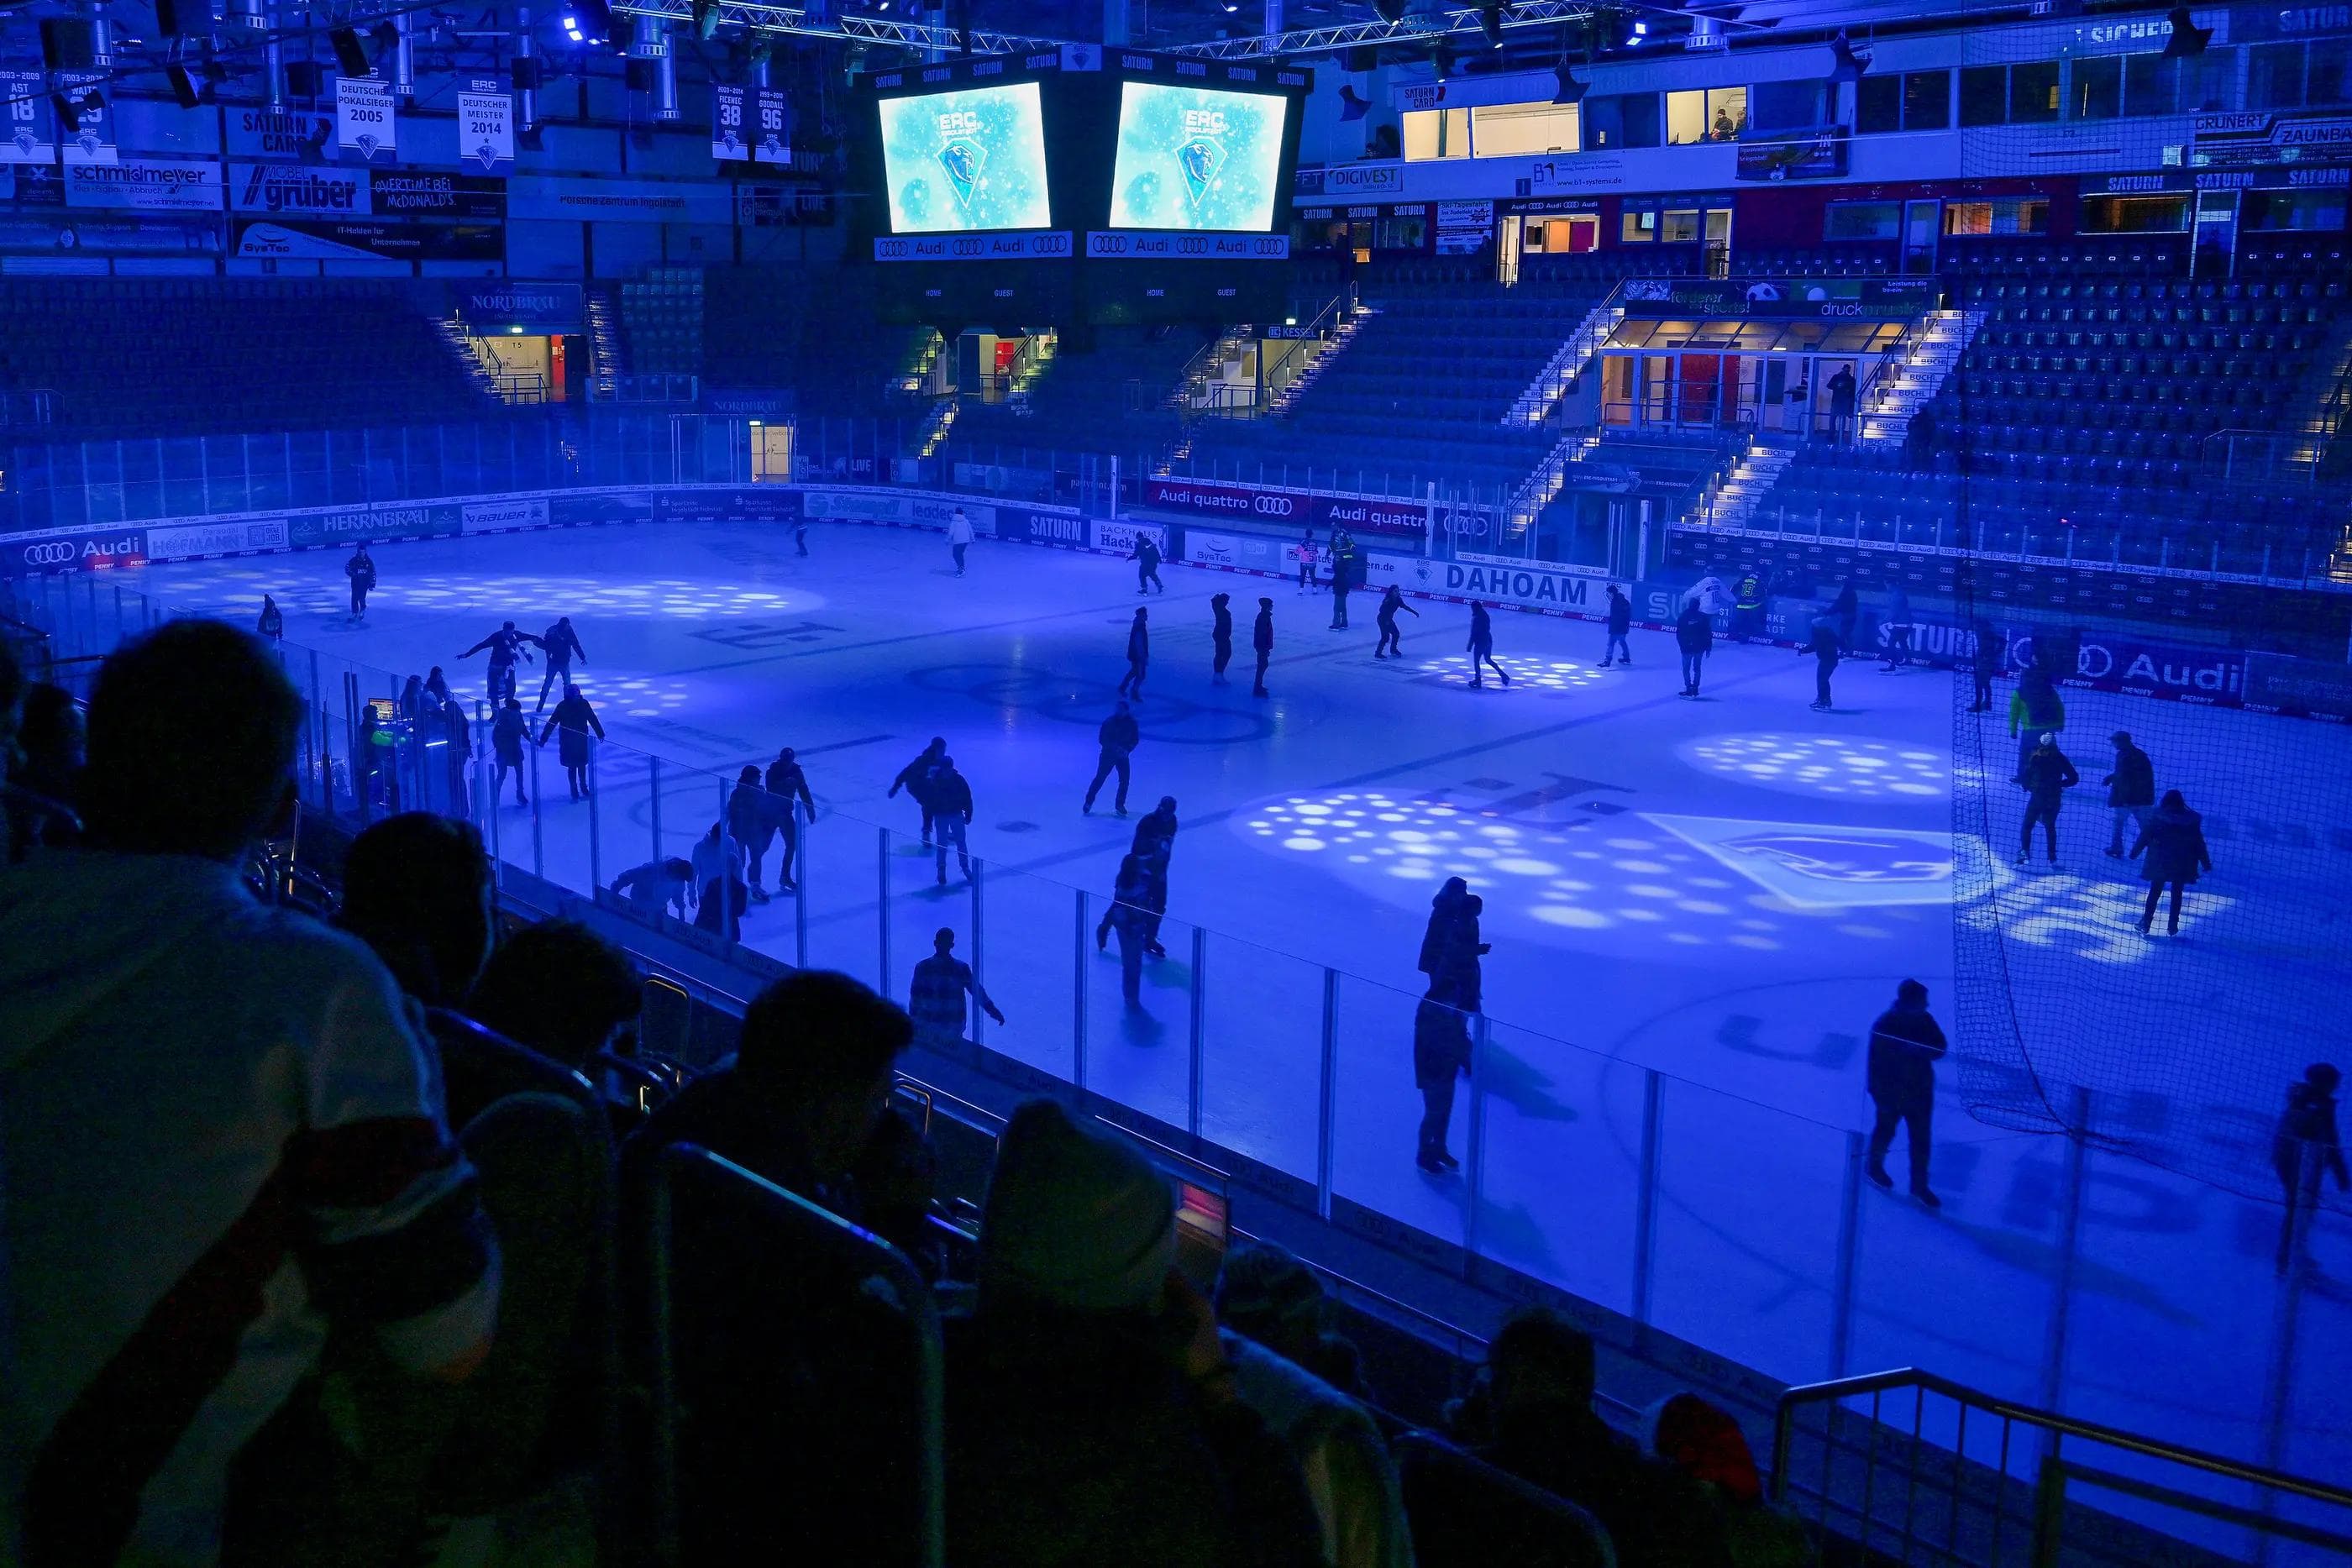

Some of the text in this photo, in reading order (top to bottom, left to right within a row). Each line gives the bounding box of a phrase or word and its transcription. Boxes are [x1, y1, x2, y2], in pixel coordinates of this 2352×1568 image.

[973, 60, 1002, 76] SATURN
[1026, 53, 1057, 70] SATURN
[1122, 55, 1153, 71] SATURN
[1176, 61, 1206, 76] SATURN
[875, 73, 901, 88] SATURN
[923, 67, 950, 82] SATURN
[1228, 67, 1257, 81] SATURN
[1278, 73, 1304, 87] SATURN
[11, 83, 29, 93] AST
[472, 80, 496, 88] ERC
[1404, 87, 1434, 99] SATURN
[8, 94, 34, 120] 18
[339, 97, 394, 108] POKALSIEGER
[464, 99, 507, 109] DEUTSCHER
[351, 109, 383, 123] 2005
[468, 110, 504, 119] MEISTER
[721, 104, 741, 126] 38
[762, 108, 782, 130] 96
[940, 112, 976, 129] ERC
[1186, 110, 1224, 128] ERC
[243, 113, 307, 134] SATURN
[472, 122, 501, 134] 2014
[73, 165, 206, 183] schmidmeyer
[1336, 169, 1397, 185] DIGIVEST
[1557, 176, 1622, 186] www.b1-systems.de
[2195, 172, 2255, 188] SATURN
[2289, 169, 2349, 184] SATURN
[2108, 175, 2163, 191] SATURN
[265, 174, 356, 212] gruber
[1303, 208, 1332, 220] SATURN
[1348, 207, 1378, 218] SATURN
[1394, 205, 1425, 216] SATURN
[244, 244, 289, 254] SysTec
[916, 239, 1024, 254] Audi Audi
[1136, 239, 1247, 254] Audi Audi
[852, 459, 871, 472] LIVE
[1159, 489, 1248, 510] Audi quattro
[1330, 506, 1365, 522] Audi
[1030, 515, 1082, 543] SATURN
[81, 538, 139, 558] Audi
[1178, 559, 1194, 568] PENNY
[1196, 551, 1232, 563] SysTec
[1234, 567, 1251, 575] PENNY
[1263, 571, 1280, 579] PENNY
[1363, 585, 1382, 593] PENNY
[1446, 564, 1587, 605] DAHOAM
[1399, 589, 1417, 598] ENNY
[1429, 593, 1450, 602] PENNY
[1499, 601, 1521, 611] PENNY
[1542, 607, 1565, 617] PENNY
[1582, 614, 1605, 623] PENNY
[1749, 636, 1773, 645] PENNY
[1853, 649, 1880, 659] PENNY
[2124, 653, 2239, 691] Audi
[2062, 678, 2094, 689] PENNY
[2121, 686, 2155, 697] PENNY
[2180, 694, 2214, 705] PENNY
